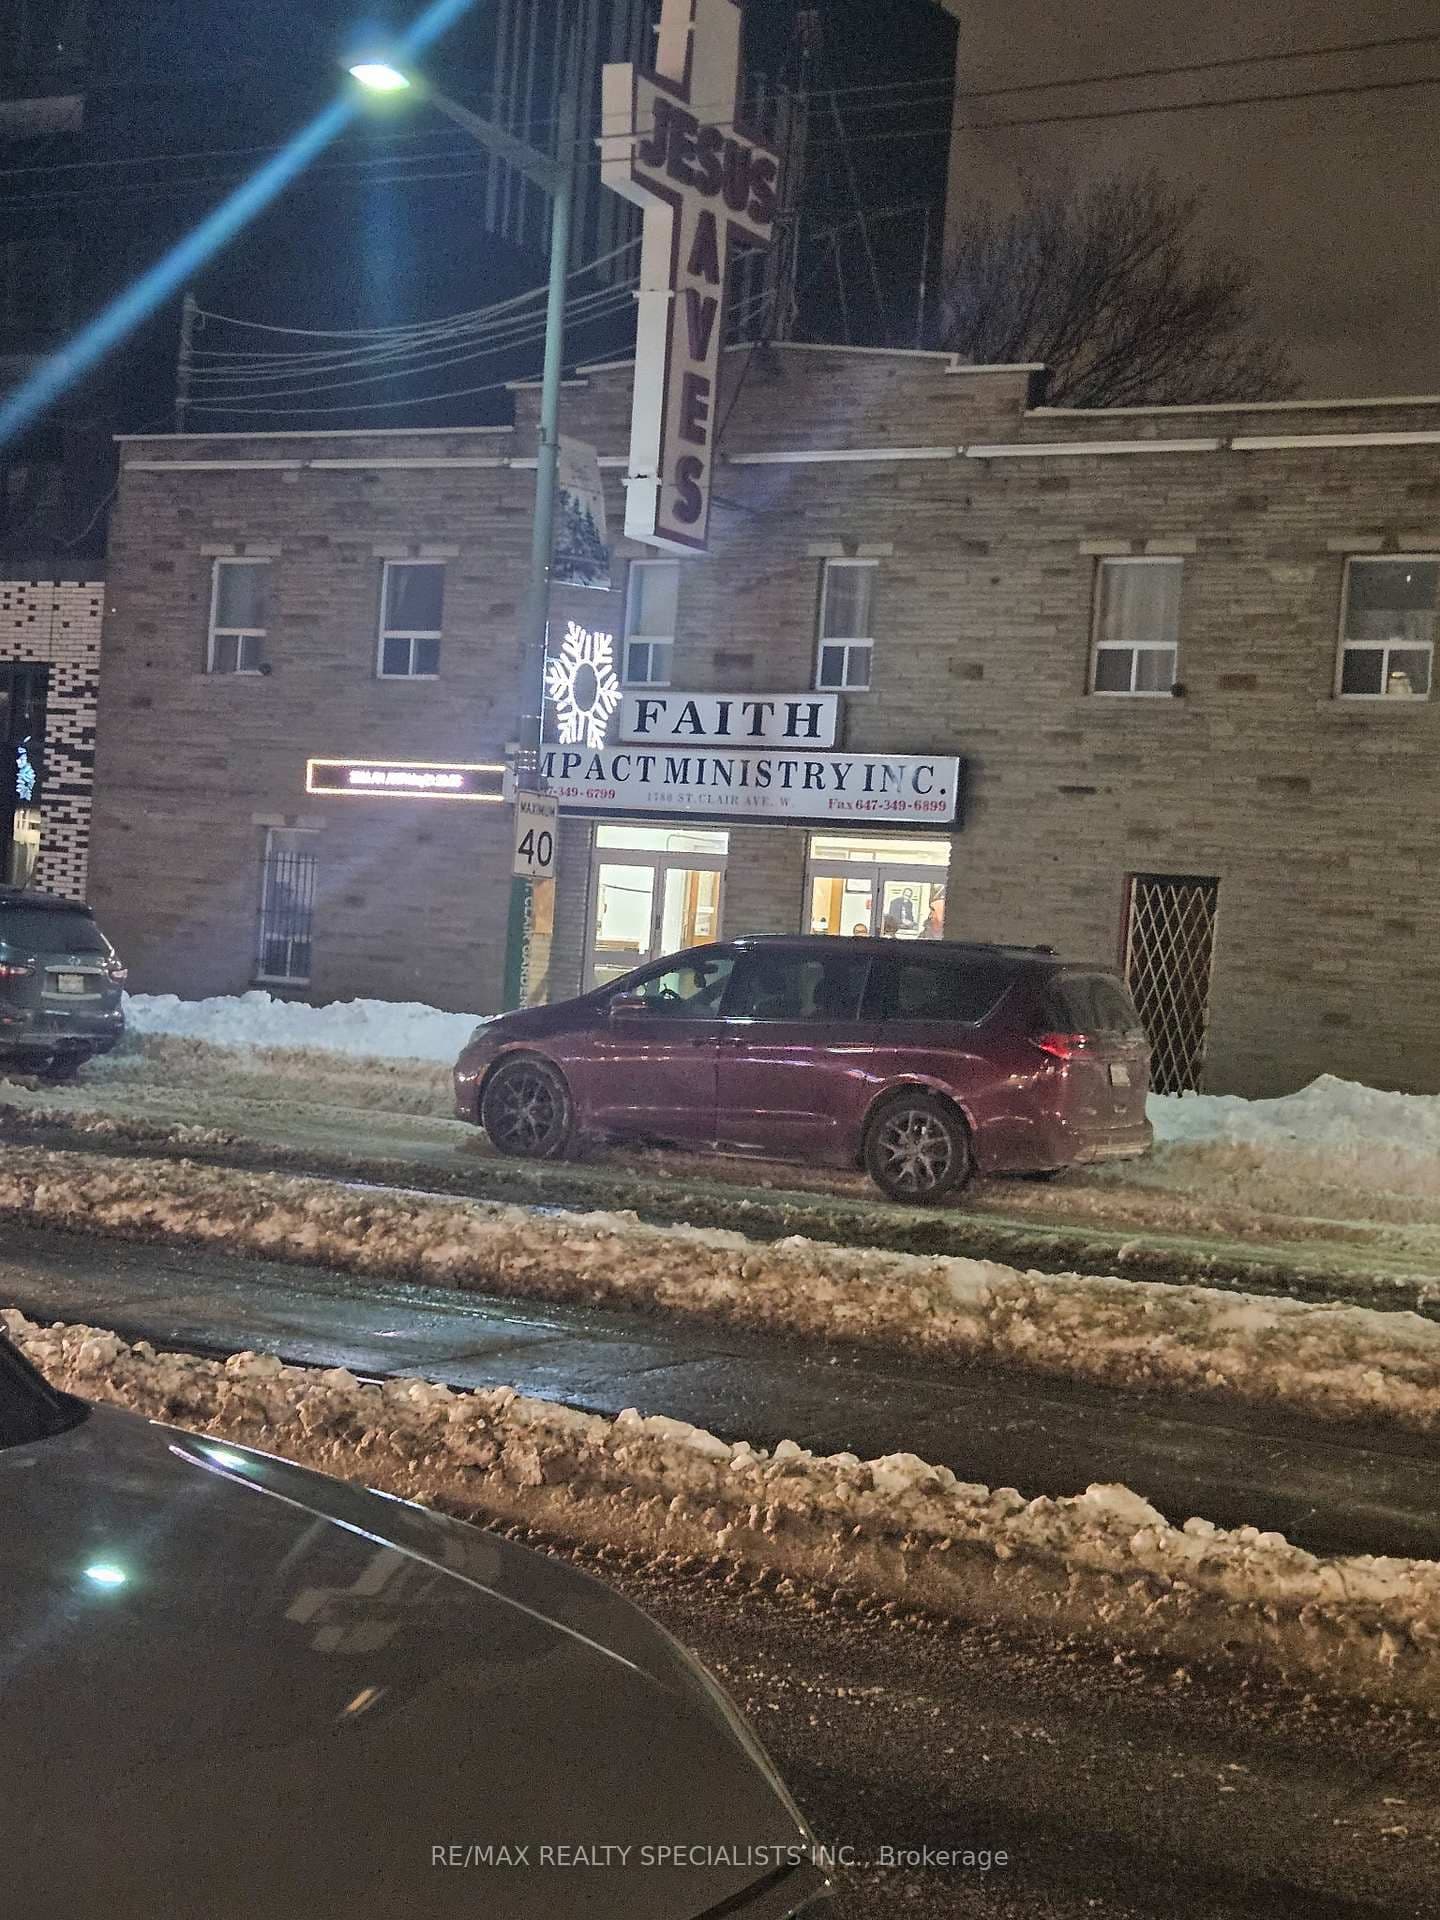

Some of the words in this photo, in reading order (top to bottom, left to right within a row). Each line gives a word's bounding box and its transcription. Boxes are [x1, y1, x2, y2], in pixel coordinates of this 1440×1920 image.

[639, 97, 778, 225] JESUS
[632, 698, 824, 739] FAITH
[541, 751, 656, 783] MPACT
[663, 756, 853, 793] MINISTRY
[862, 763, 948, 796] INC.
[518, 829, 553, 867] 40
